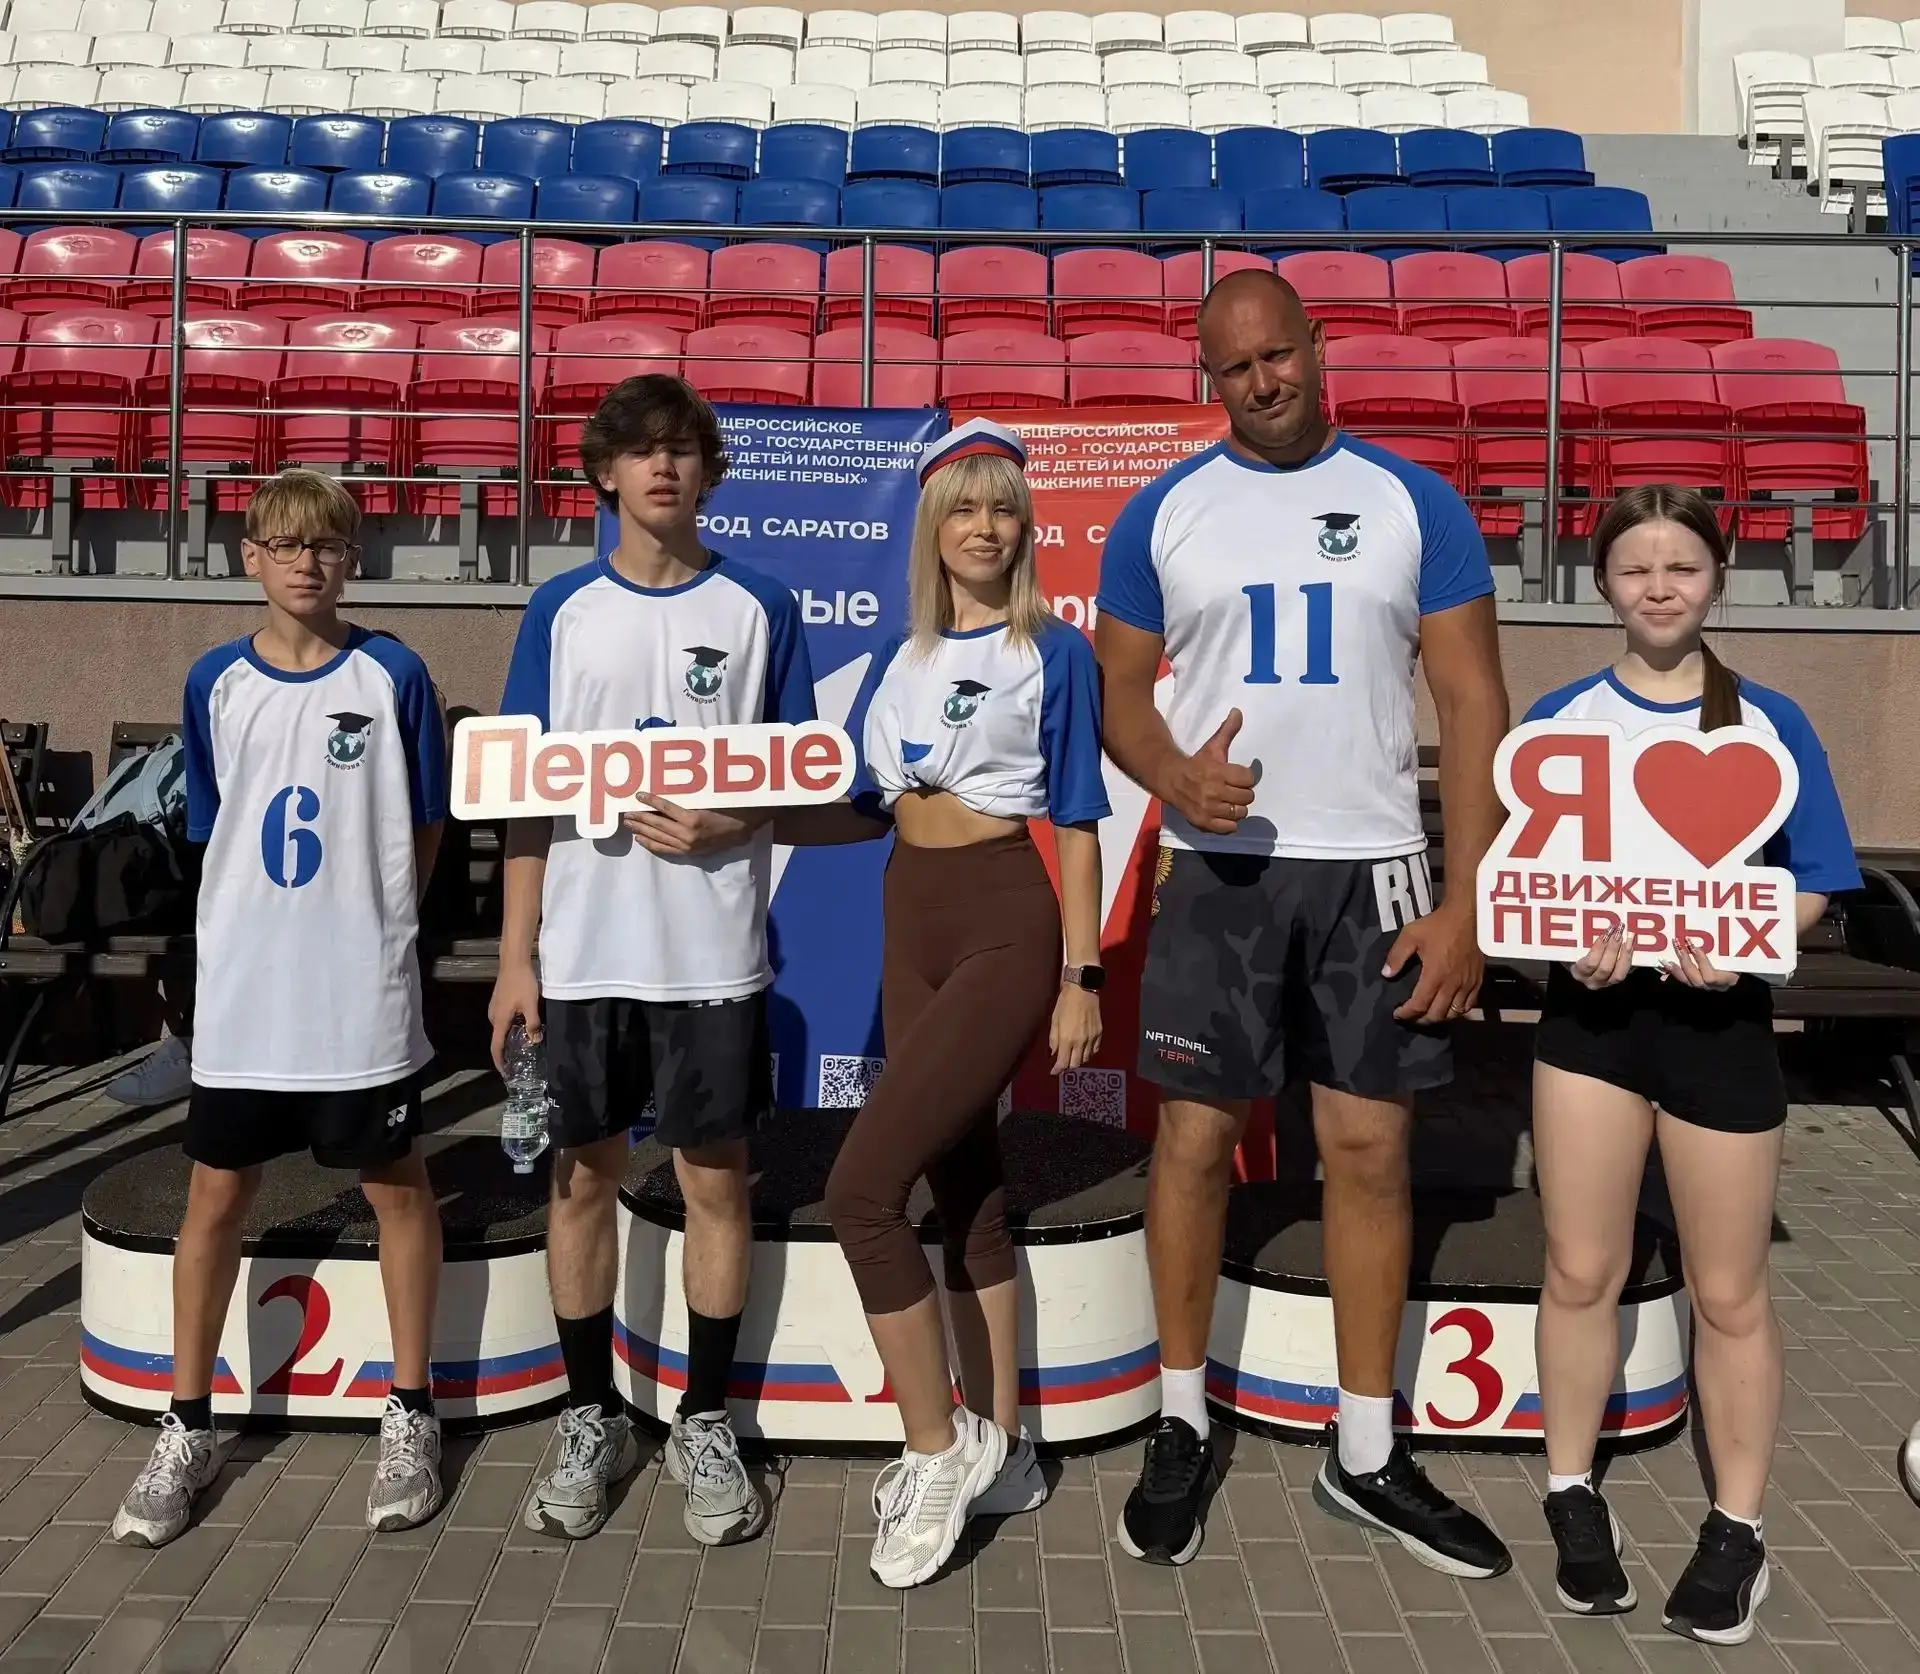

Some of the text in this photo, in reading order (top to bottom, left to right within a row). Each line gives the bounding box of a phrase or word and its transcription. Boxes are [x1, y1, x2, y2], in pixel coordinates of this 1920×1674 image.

[718, 417, 862, 434] ЩЕРОССИЙСКОЕ
[736, 451, 793, 465] ДЕТЕЙ
[796, 454, 808, 466] И
[812, 455, 914, 470] МОЛОДЕЖИ
[1082, 440, 1220, 456] ГОСУДАРСТВЕН
[722, 468, 868, 484] ЖЕНИЕ ПЕРВЫХ»
[1052, 457, 1109, 474] ДЕТЕЙ
[1112, 459, 1125, 471] И
[1107, 475, 1156, 488] ПЕРВ
[762, 517, 889, 540] САРАТОВ
[1241, 582, 1340, 685] 11
[464, 728, 843, 825] Первые
[1506, 733, 1612, 863] Я
[261, 785, 323, 889] 6
[1489, 870, 1778, 911] ДВИЖЕНИЕ
[1493, 904, 1781, 960] ПЕРВЫХ
[1145, 1030, 1212, 1055] NATIONAL
[1158, 1048, 1195, 1065] TEAM
[256, 1274, 346, 1398] 2
[1425, 1307, 1505, 1430] 3
